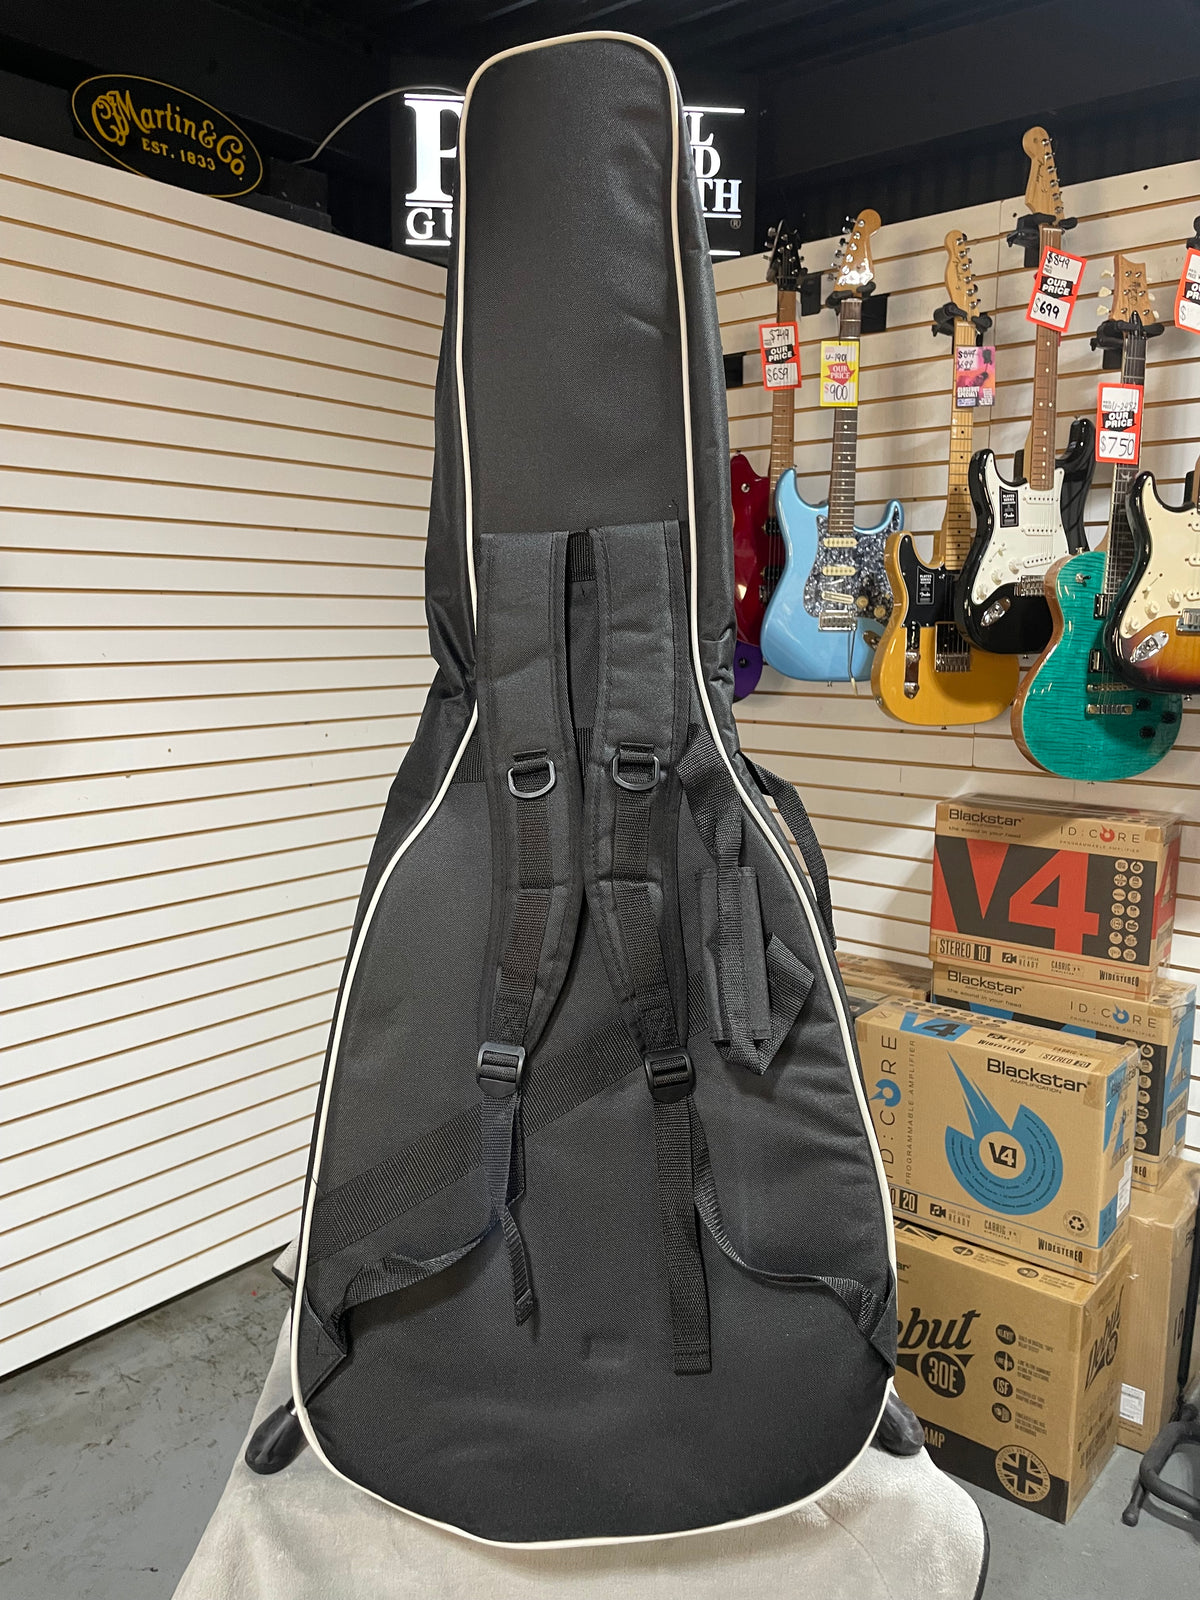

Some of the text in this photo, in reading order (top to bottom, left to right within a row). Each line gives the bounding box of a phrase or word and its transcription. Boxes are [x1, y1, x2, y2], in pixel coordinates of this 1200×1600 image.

[684, 112, 715, 146] L
[141, 137, 216, 171] EST. 1833
[1046, 251, 1071, 269] $849
[1041, 284, 1071, 296] PRICE
[1046, 277, 1068, 288] OUR
[1032, 297, 1060, 320] $699
[768, 351, 793, 362] PRICE
[770, 345, 788, 355] OUR
[767, 367, 789, 383] $659
[830, 371, 851, 379] PRICE
[832, 364, 849, 372] OUR
[824, 383, 849, 401] $900
[1104, 418, 1133, 429] PRICE
[1108, 411, 1129, 421] OUR
[1100, 435, 1135, 457] $750
[949, 808, 1022, 827] Blackstar
[940, 938, 987, 961] STEREO 10
[947, 970, 1023, 995] Blackstar
[1043, 1053, 1073, 1064] STEREO
[986, 1057, 1088, 1093] Blackstar
[1010, 1078, 1062, 1094] AMPLIFICATION
[988, 1141, 1017, 1169] V4
[902, 1192, 915, 1212] 20
[1038, 1237, 1083, 1263] WIDESTEREO
[897, 1307, 982, 1350] but
[928, 1356, 958, 1394] 30E
[996, 1378, 1009, 1395] ISF
[924, 1426, 946, 1448] AMP
